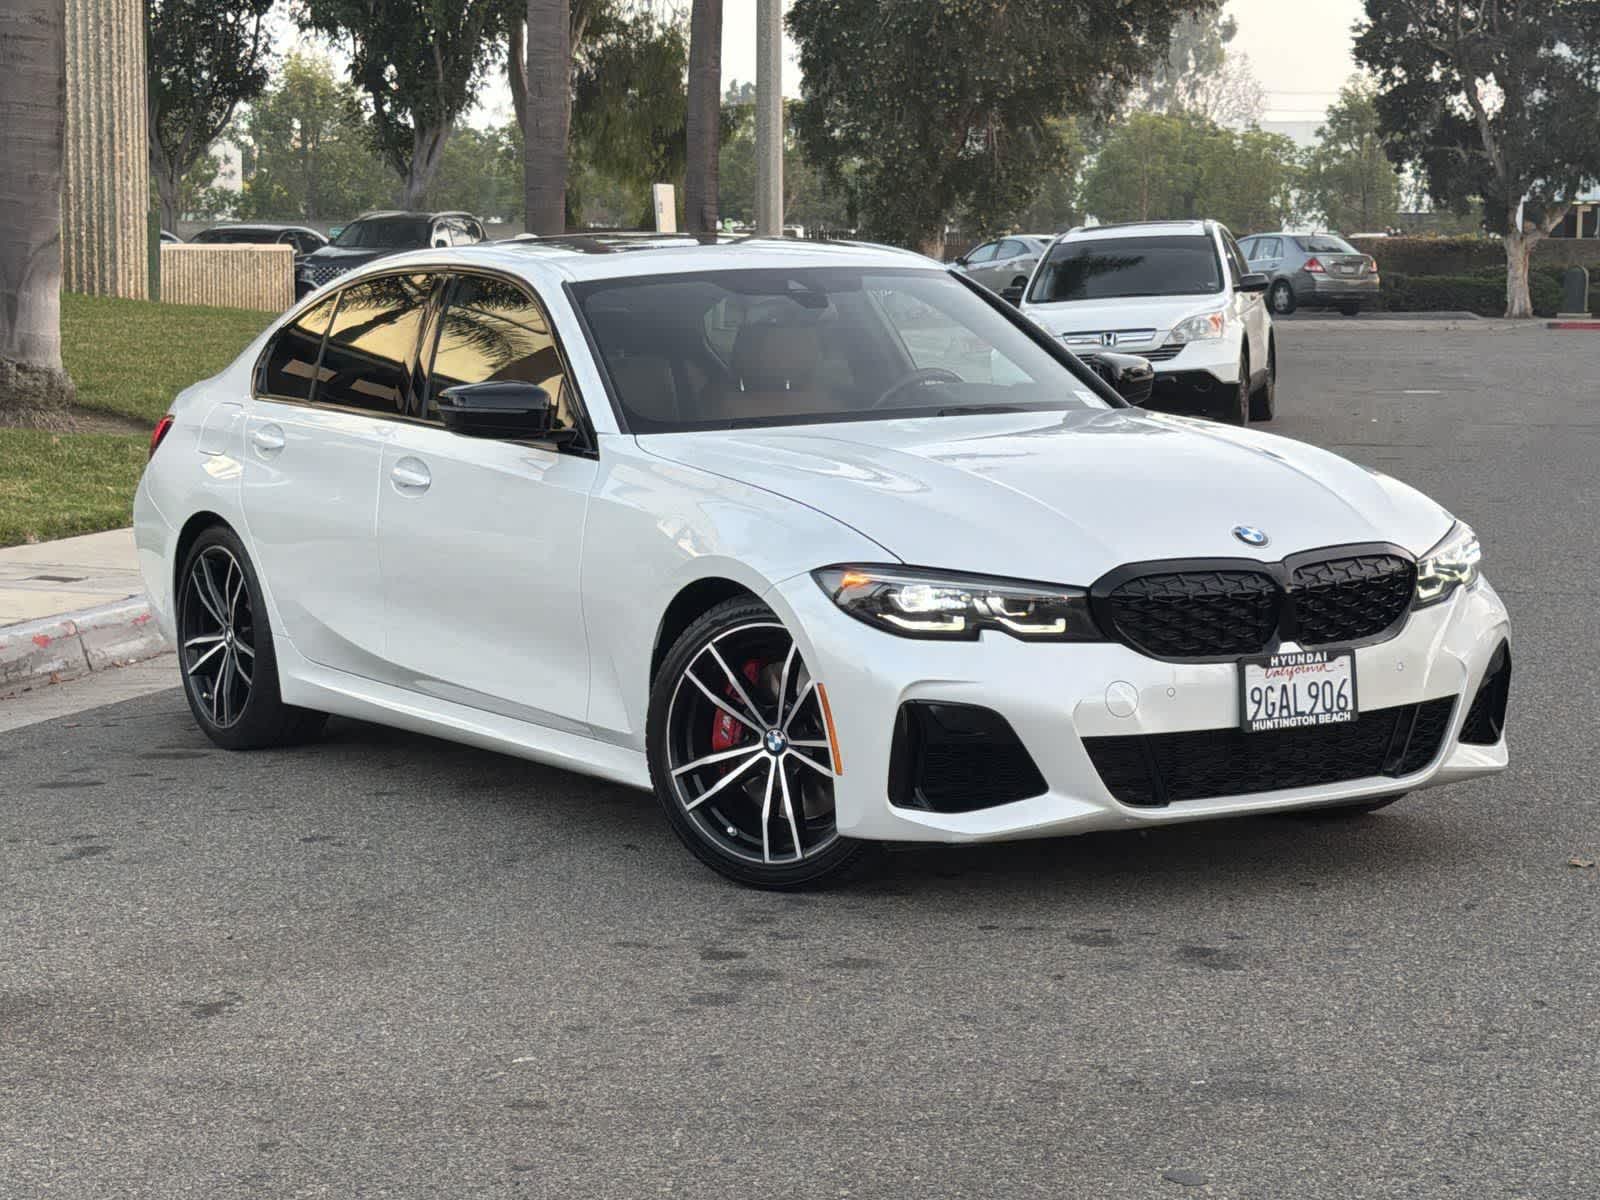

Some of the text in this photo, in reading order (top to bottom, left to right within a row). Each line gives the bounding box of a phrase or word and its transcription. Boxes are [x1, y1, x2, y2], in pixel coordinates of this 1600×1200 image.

[1270, 651, 1327, 666] HYUNDAI
[1250, 678, 1348, 720] 9GAL906
[1252, 712, 1351, 731] HUNTINGTON BEACH
